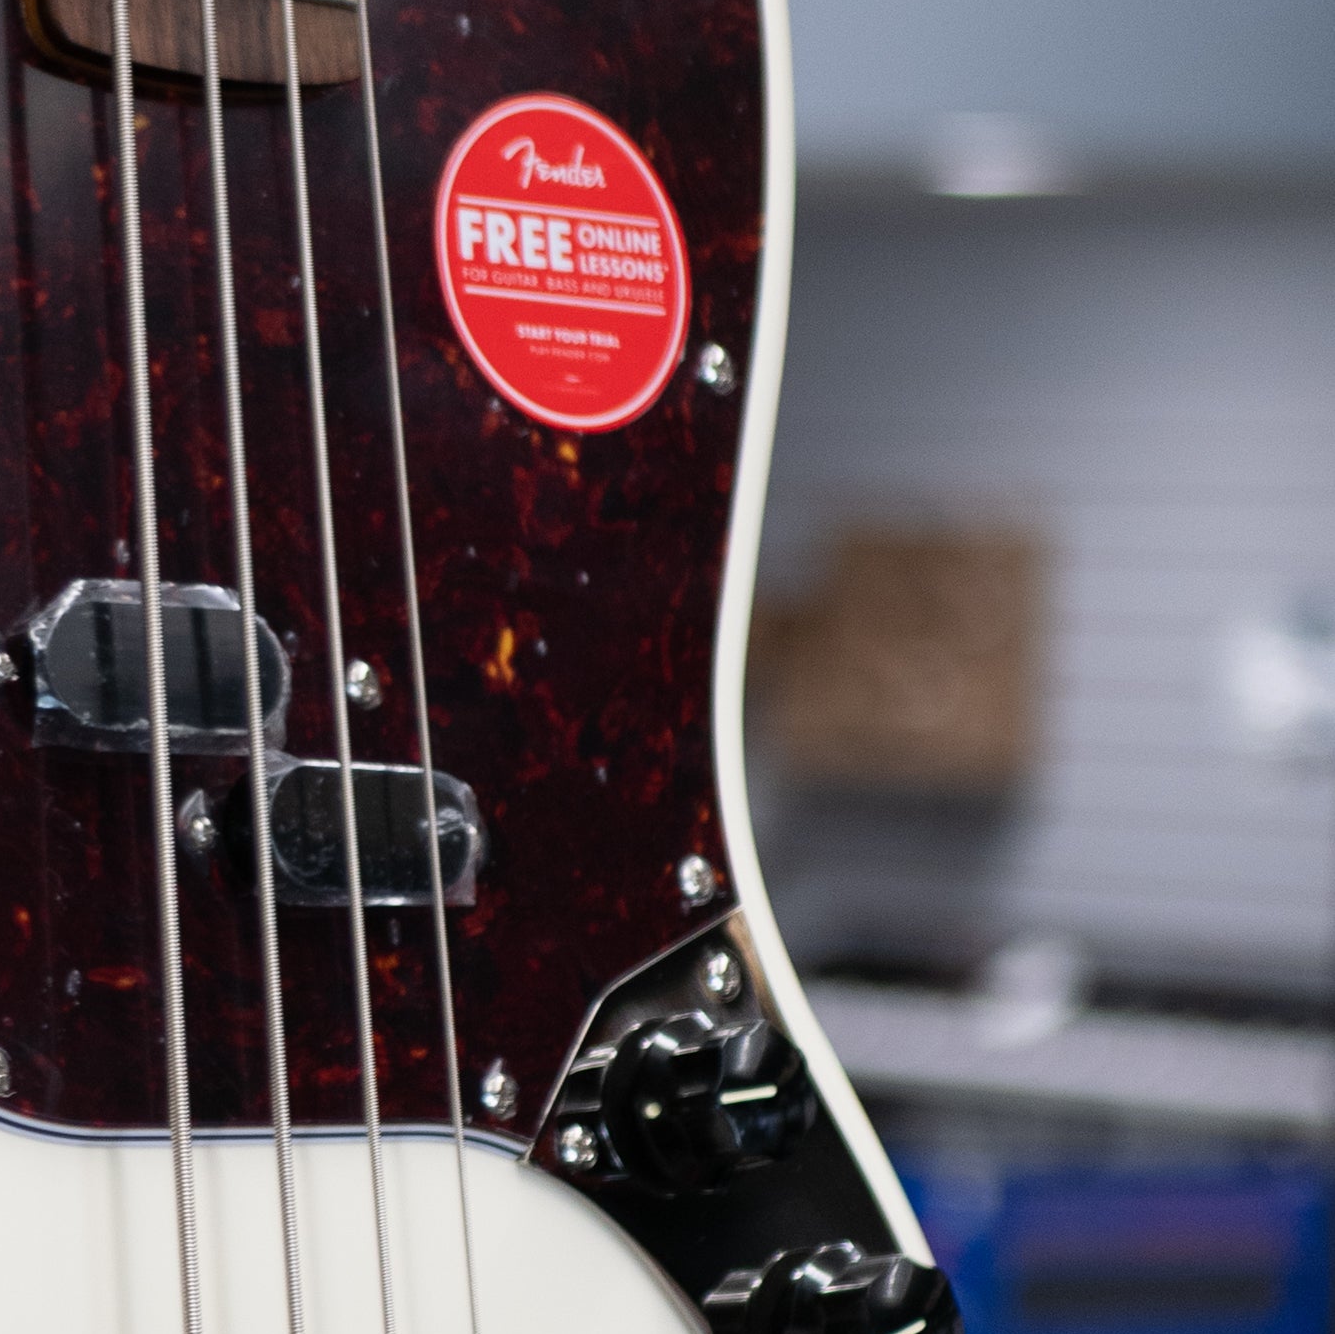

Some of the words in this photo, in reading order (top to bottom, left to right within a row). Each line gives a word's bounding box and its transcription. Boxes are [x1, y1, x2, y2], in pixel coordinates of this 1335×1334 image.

[501, 136, 606, 189] Fender
[456, 209, 574, 273] FREE
[577, 223, 662, 257] ONLINE
[546, 276, 580, 294] BASS
[553, 327, 587, 346] YOUR
